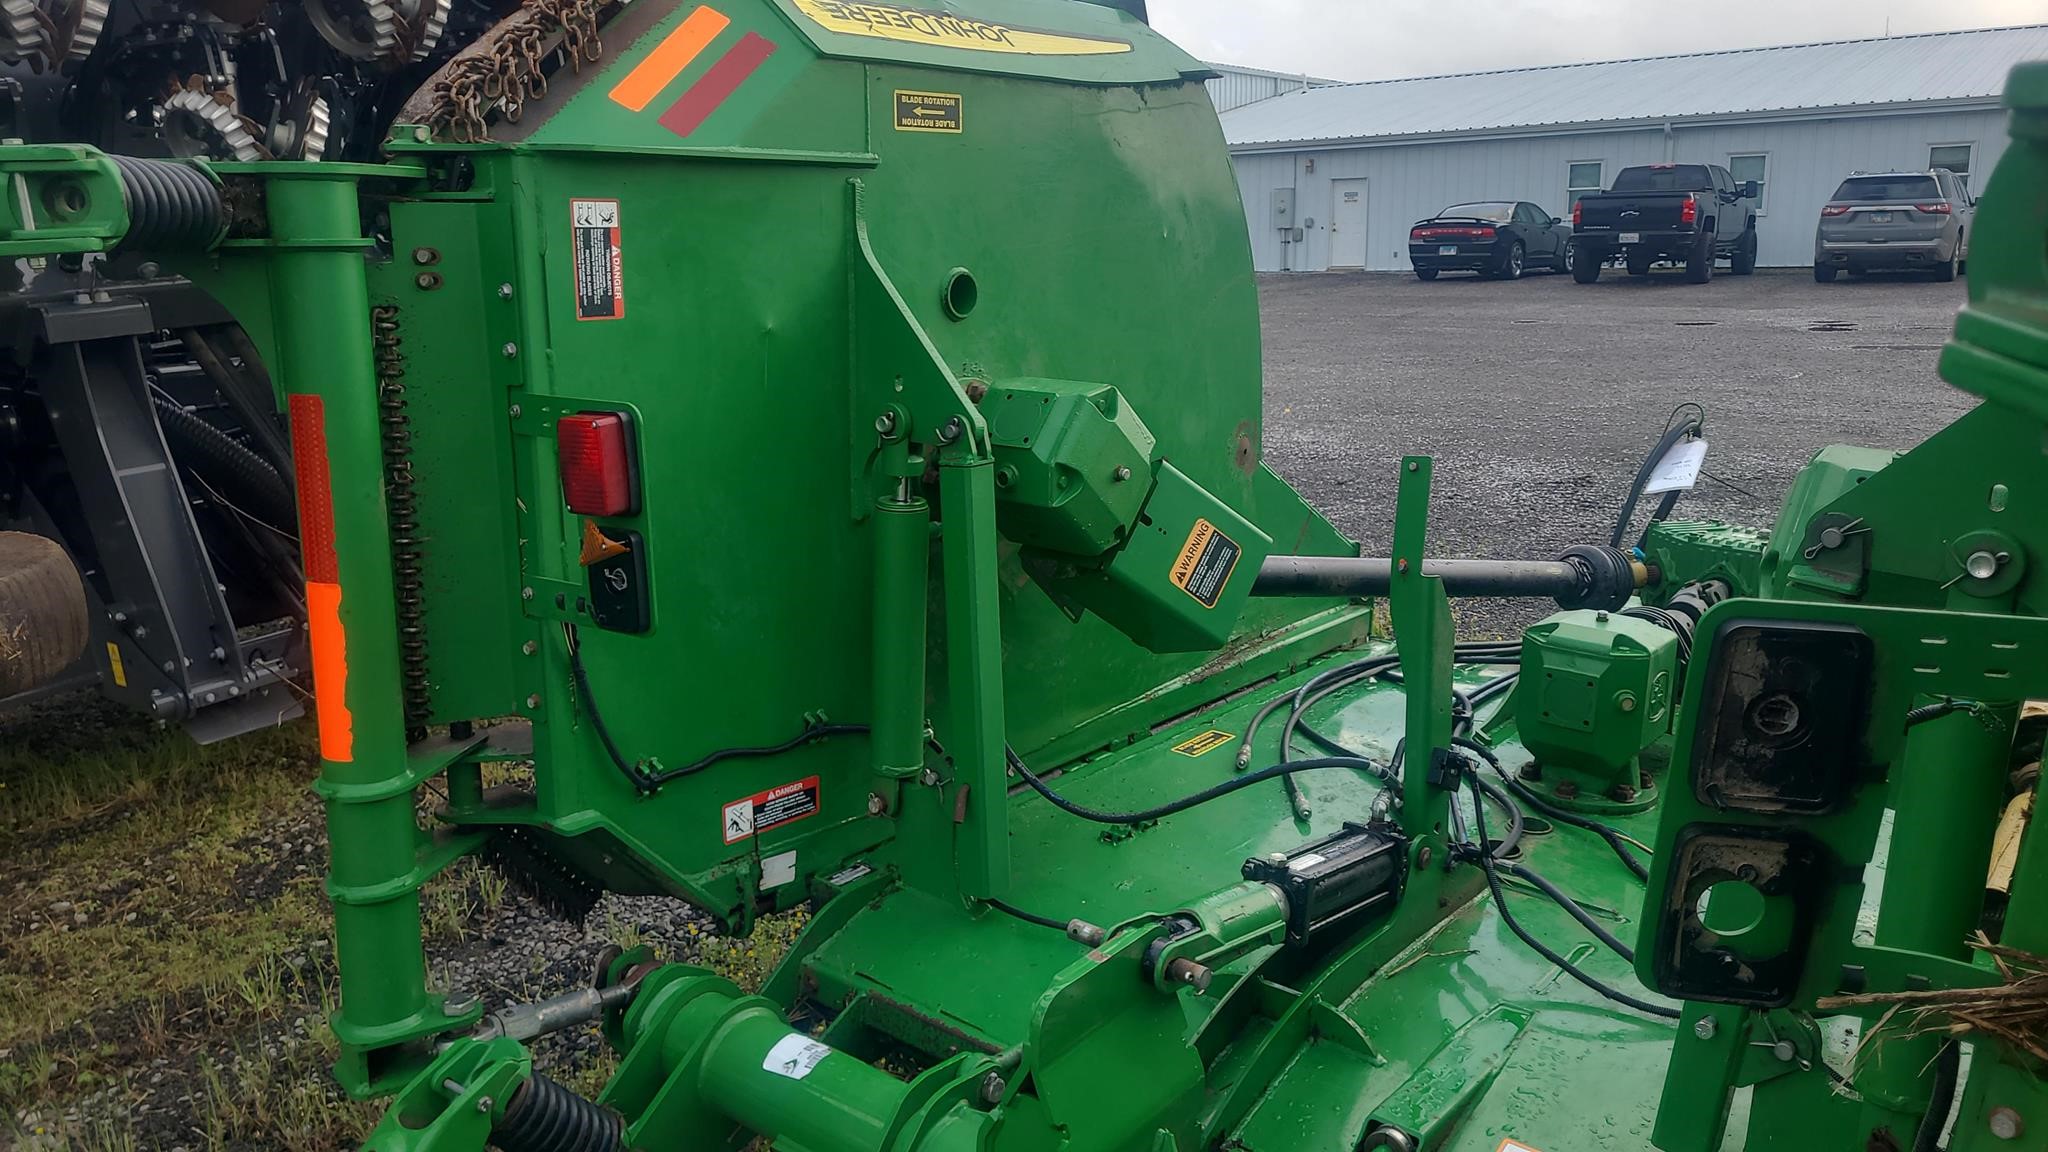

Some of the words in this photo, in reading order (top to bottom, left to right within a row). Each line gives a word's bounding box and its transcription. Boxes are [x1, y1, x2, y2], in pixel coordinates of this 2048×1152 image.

[829, 3, 940, 37] DEERE
[931, 13, 1015, 47] JOHN
[901, 95, 923, 104] BLADE
[923, 96, 956, 106] ROTATION
[901, 117, 934, 127] ROTATION
[935, 119, 956, 128] BLADE
[613, 257, 622, 300] DANGER
[1180, 522, 1210, 570] WARNING
[775, 782, 804, 798] DANGER
